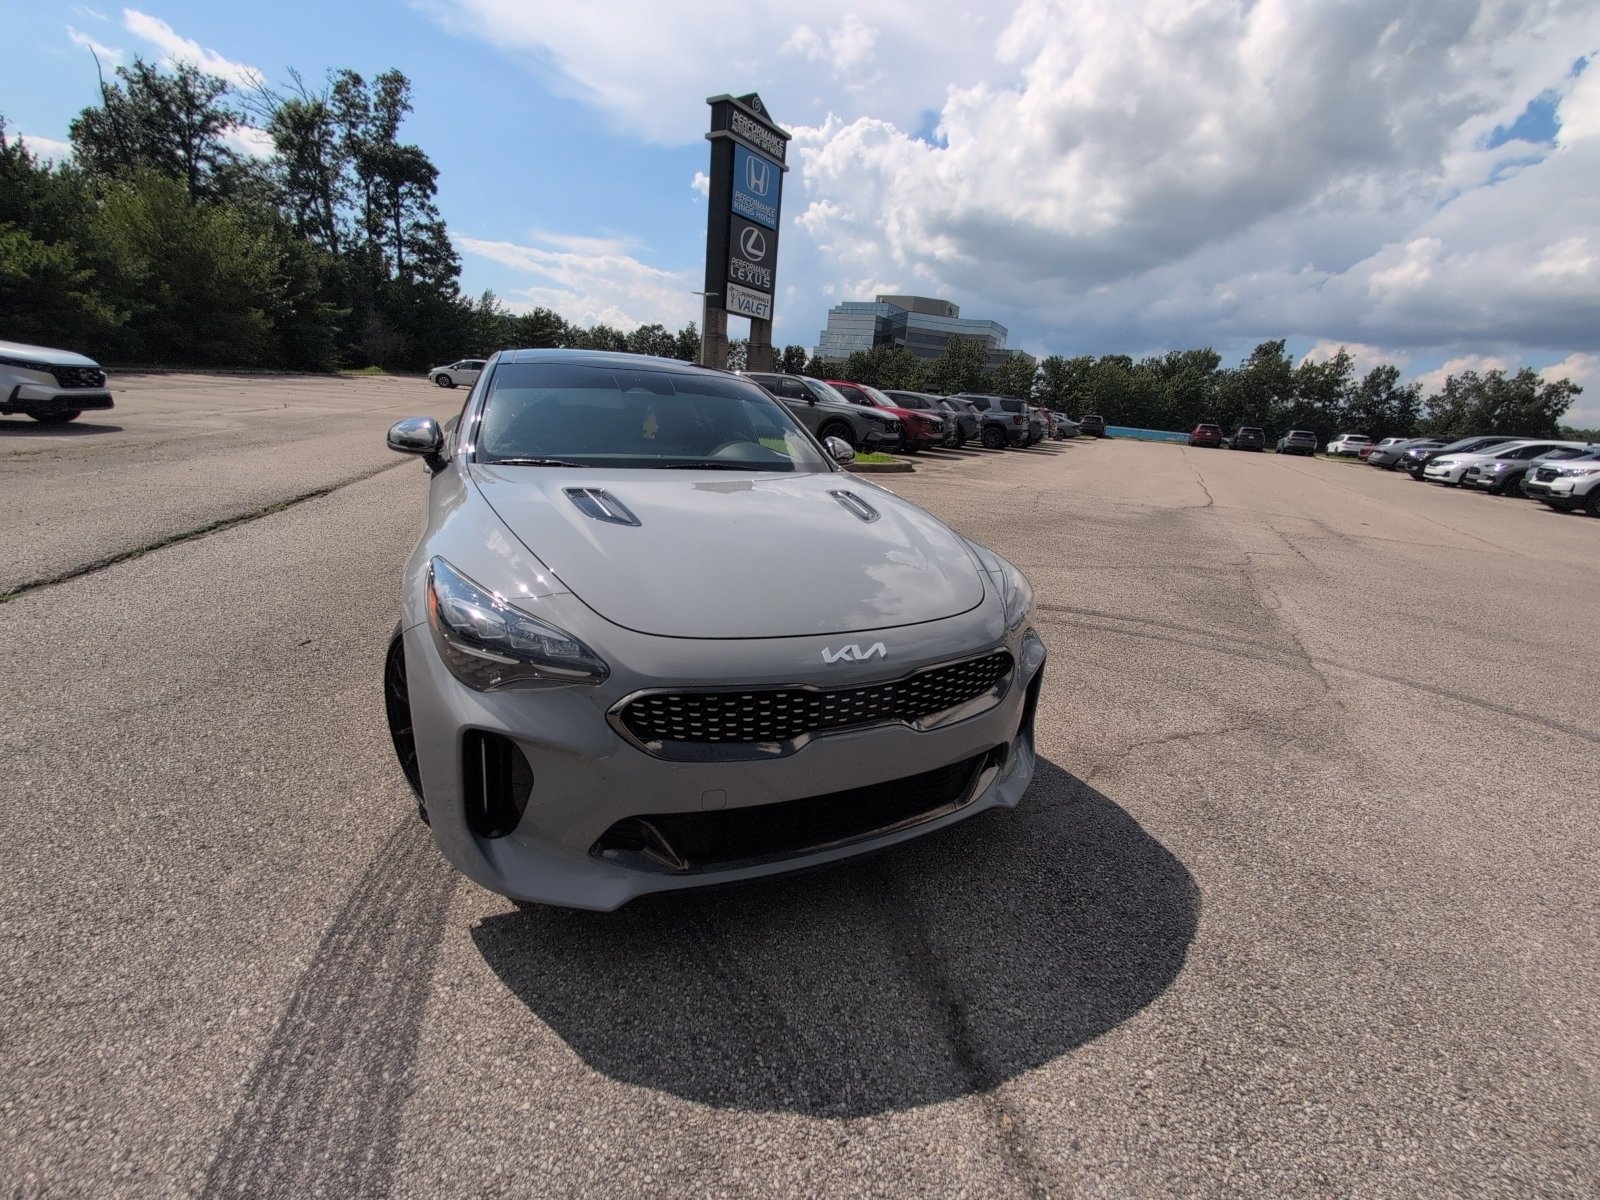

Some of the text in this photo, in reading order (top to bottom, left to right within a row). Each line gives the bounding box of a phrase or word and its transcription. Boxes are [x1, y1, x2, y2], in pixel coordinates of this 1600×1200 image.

[731, 123, 761, 145] AUTOMOTIVE
[732, 110, 785, 147] PERFORMANCE
[735, 190, 776, 217] PERFORMANCE
[730, 265, 771, 288] LEXUS
[731, 257, 771, 277] PERFORMANCE
[738, 297, 768, 316] VALET
[821, 642, 887, 663] KIA
